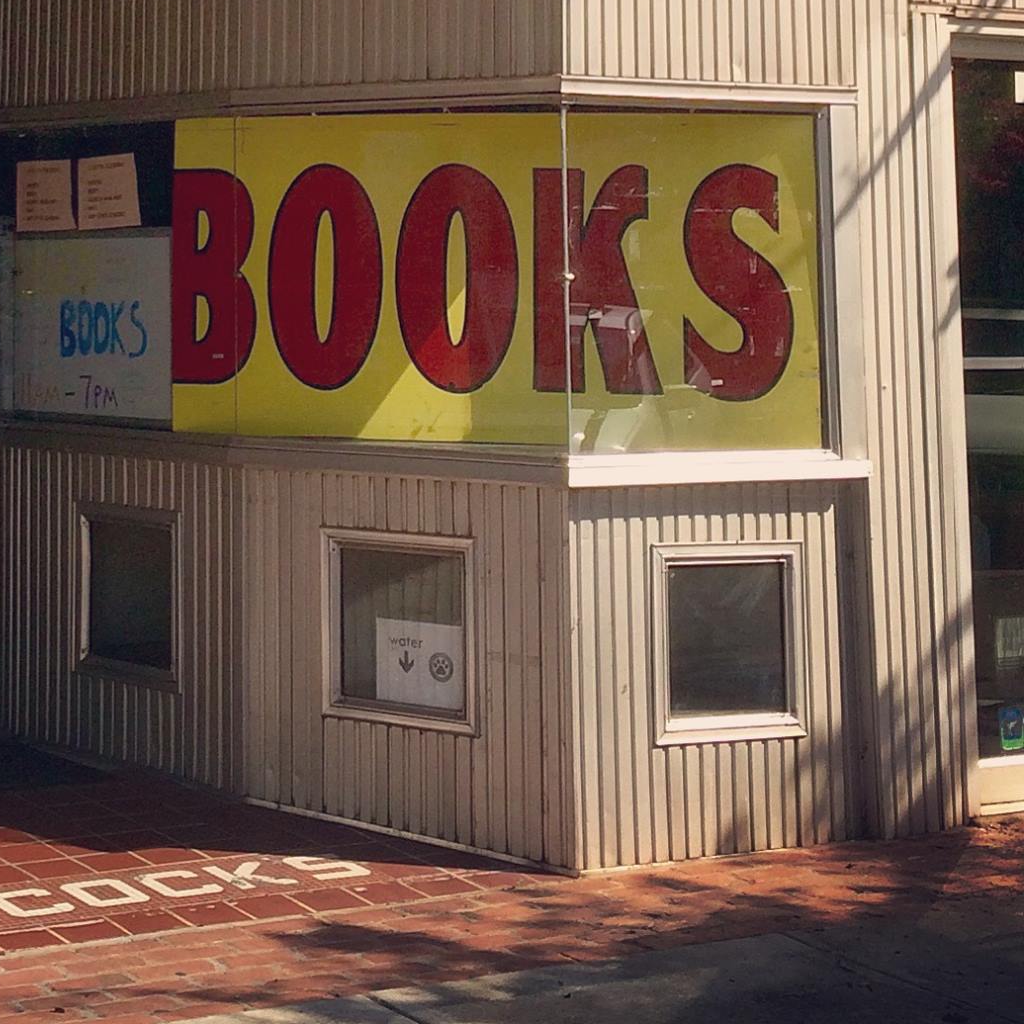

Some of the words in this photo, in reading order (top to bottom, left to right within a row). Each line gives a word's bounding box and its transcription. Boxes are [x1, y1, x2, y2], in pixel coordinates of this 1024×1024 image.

[172, 163, 795, 402] BOOKS
[60, 299, 147, 358] BOOKS
[80, 375, 118, 408] 7PM
[388, 634, 424, 650] water
